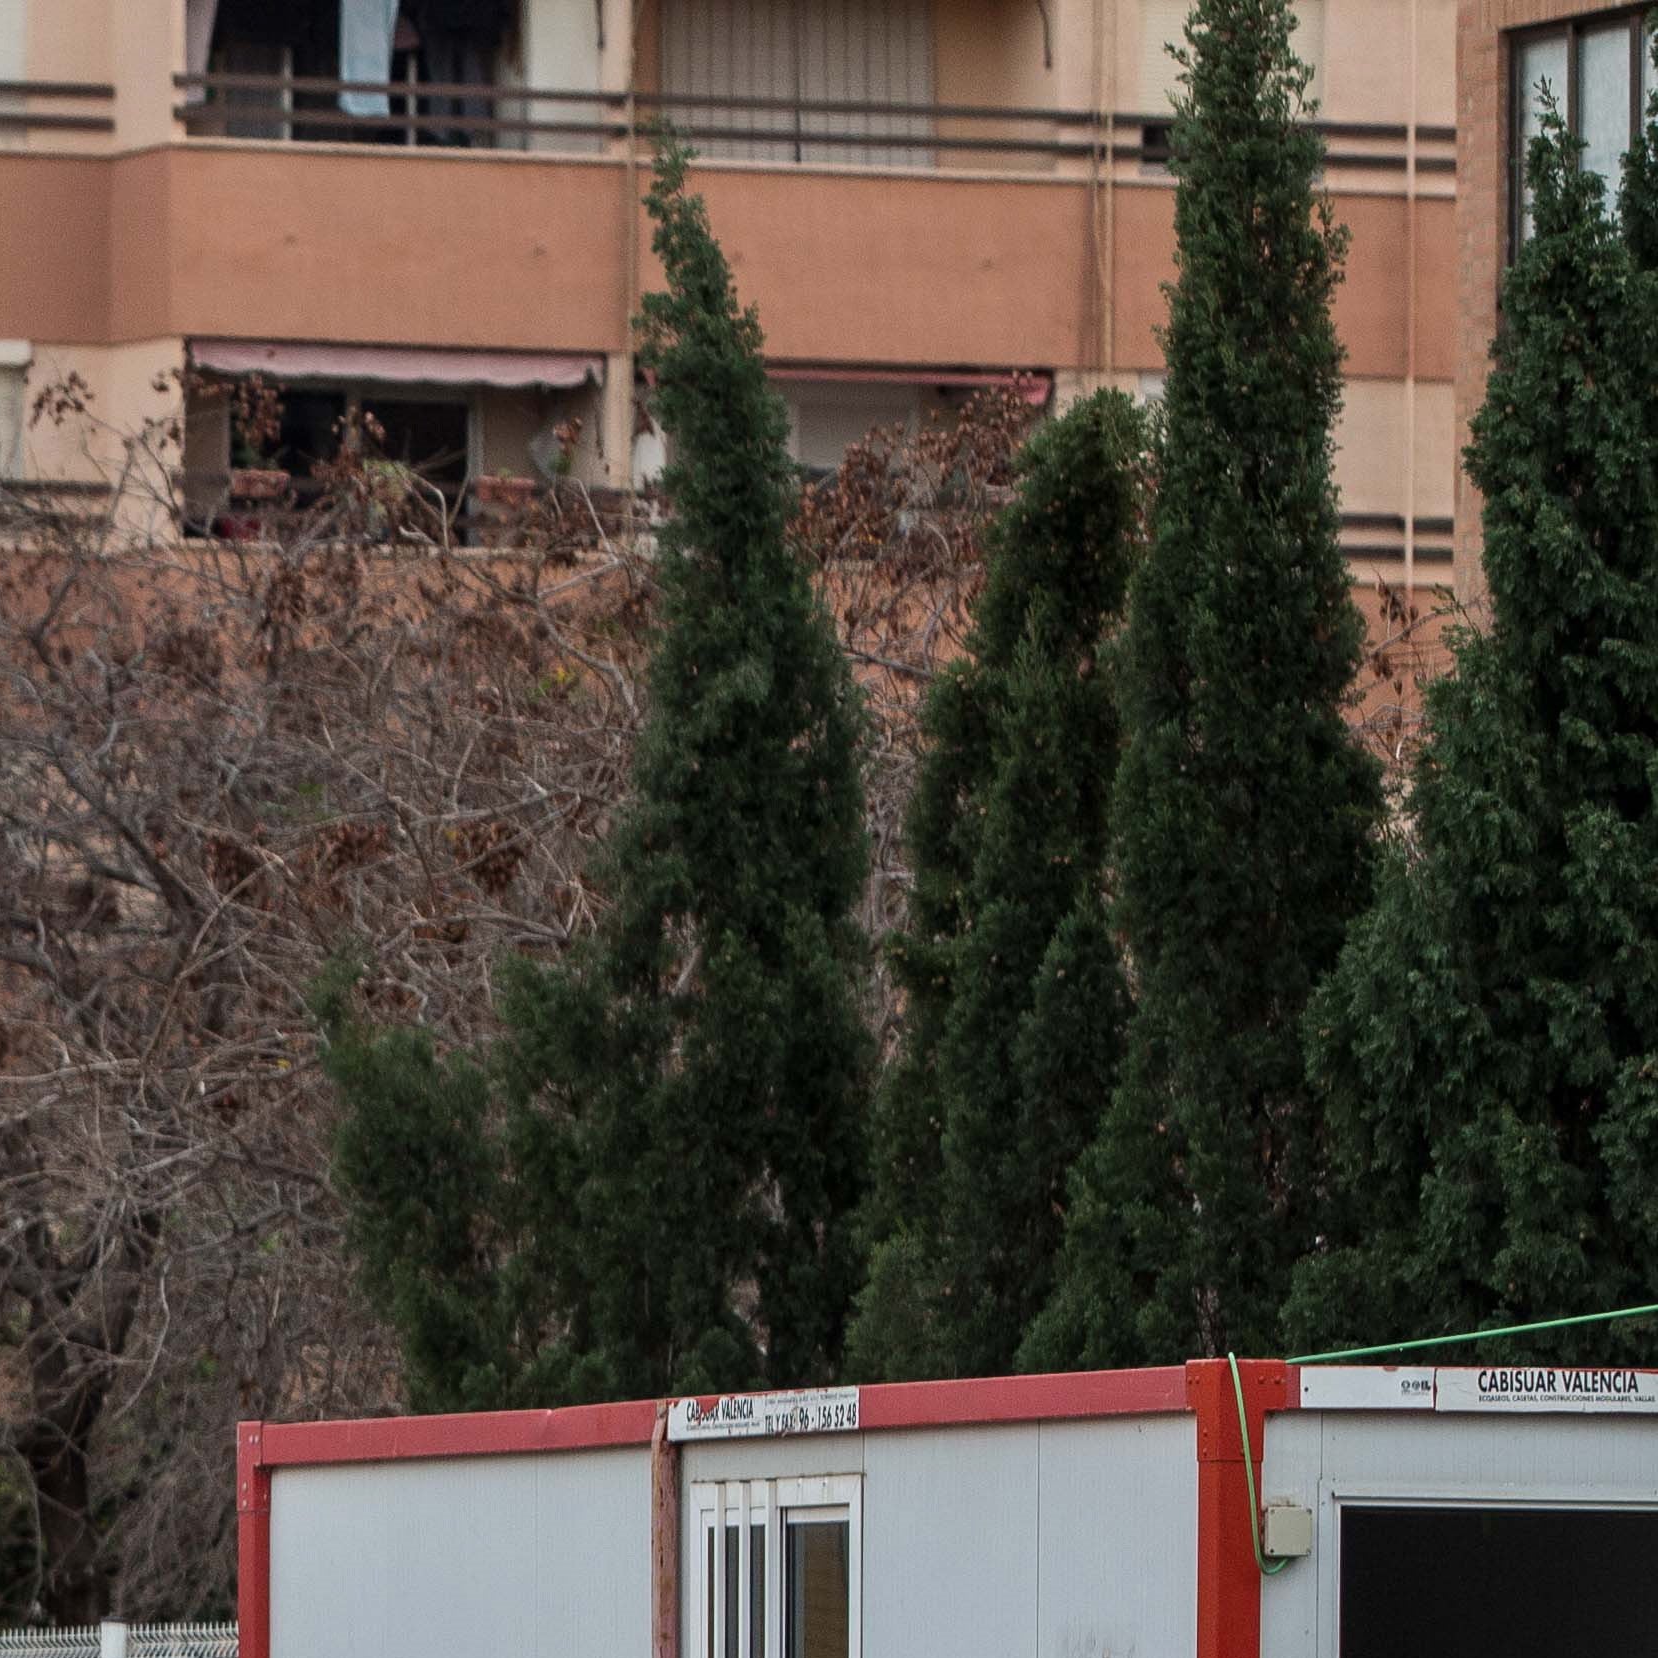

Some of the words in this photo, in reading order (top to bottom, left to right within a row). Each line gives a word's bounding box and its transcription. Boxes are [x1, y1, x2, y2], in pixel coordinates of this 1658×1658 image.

[1478, 1370, 1556, 1393] CABISUAR
[1562, 1370, 1639, 1393] VALENCIA
[686, 1400, 719, 1422] CABAR
[721, 1398, 754, 1421] VALENCIA
[798, 1407, 810, 1430] 96
[817, 1405, 832, 1428] 156
[834, 1404, 845, 1428] 52
[846, 1403, 857, 1426] 48
